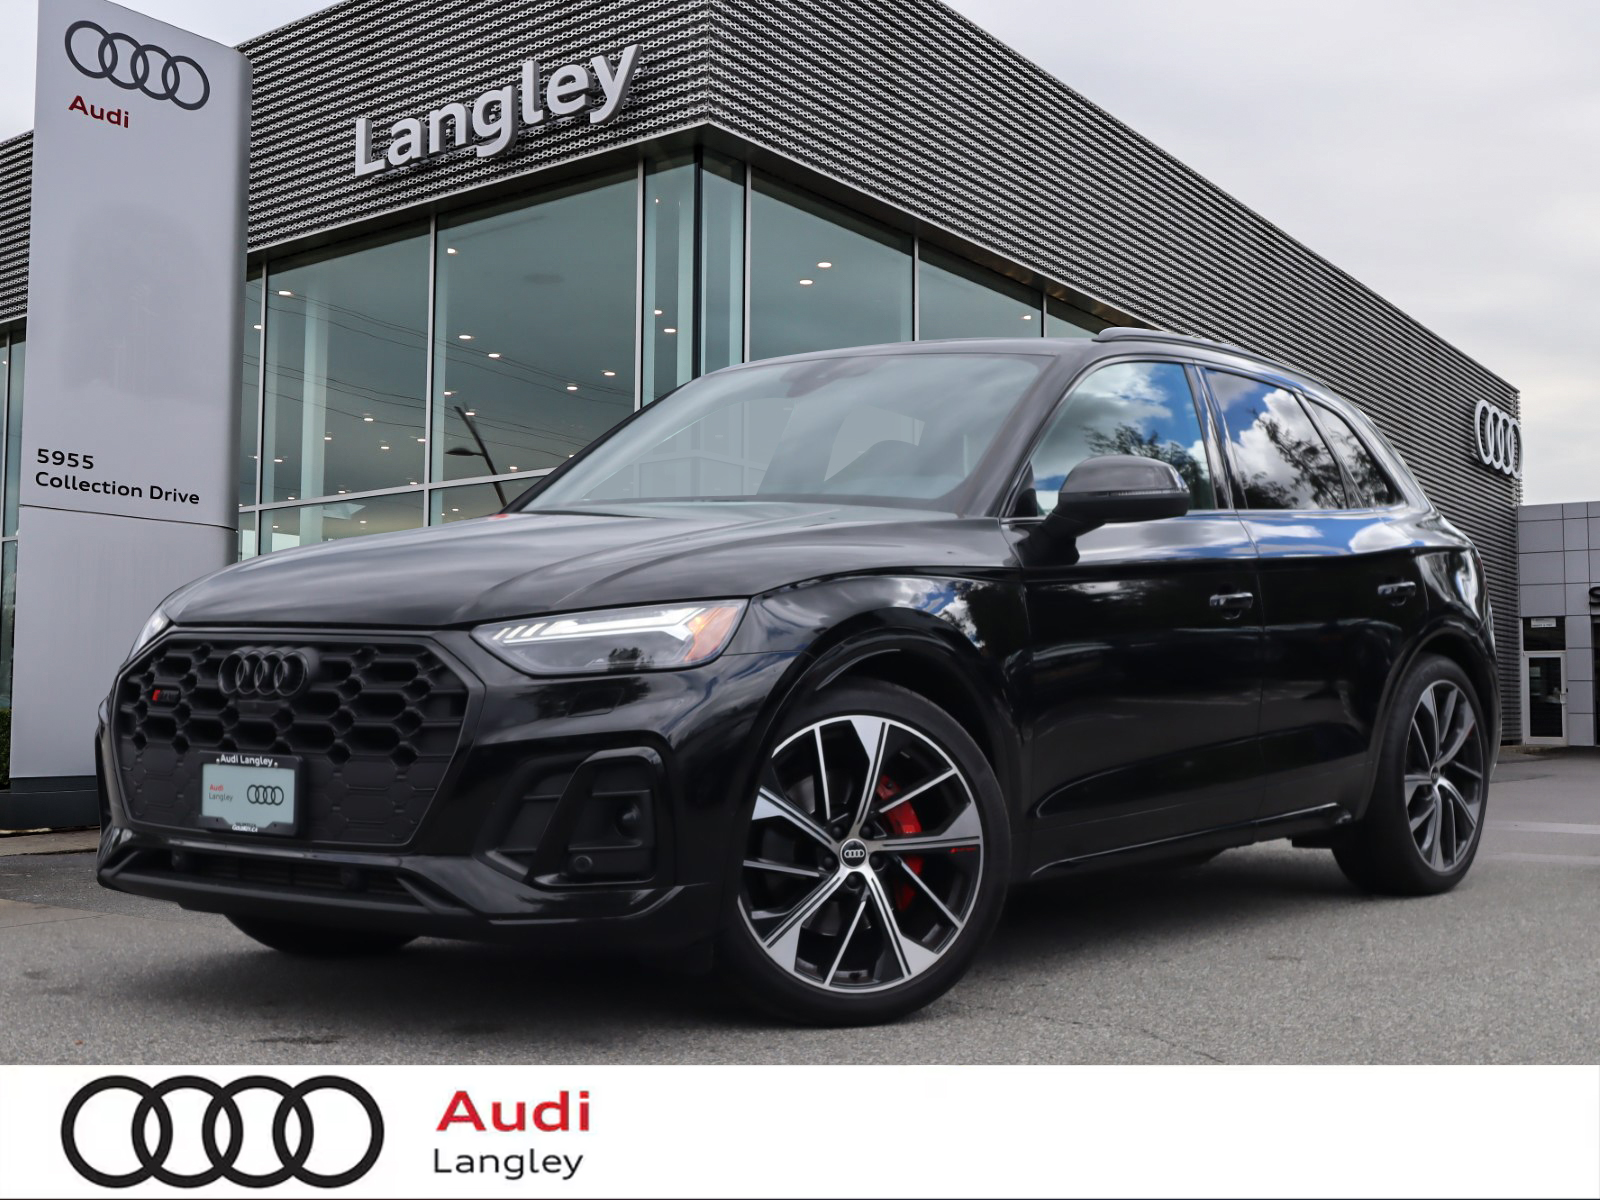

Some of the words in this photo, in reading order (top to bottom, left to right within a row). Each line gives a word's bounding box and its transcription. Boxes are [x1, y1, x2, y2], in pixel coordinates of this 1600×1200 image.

[68, 95, 130, 128] Audi
[355, 44, 643, 176] Langley
[36, 448, 94, 469] 5955
[35, 472, 143, 498] Collection
[149, 485, 200, 504] Drive
[220, 754, 239, 764] Audi
[240, 756, 273, 767] Langley
[208, 793, 233, 802] Langley
[209, 784, 224, 792] Audi
